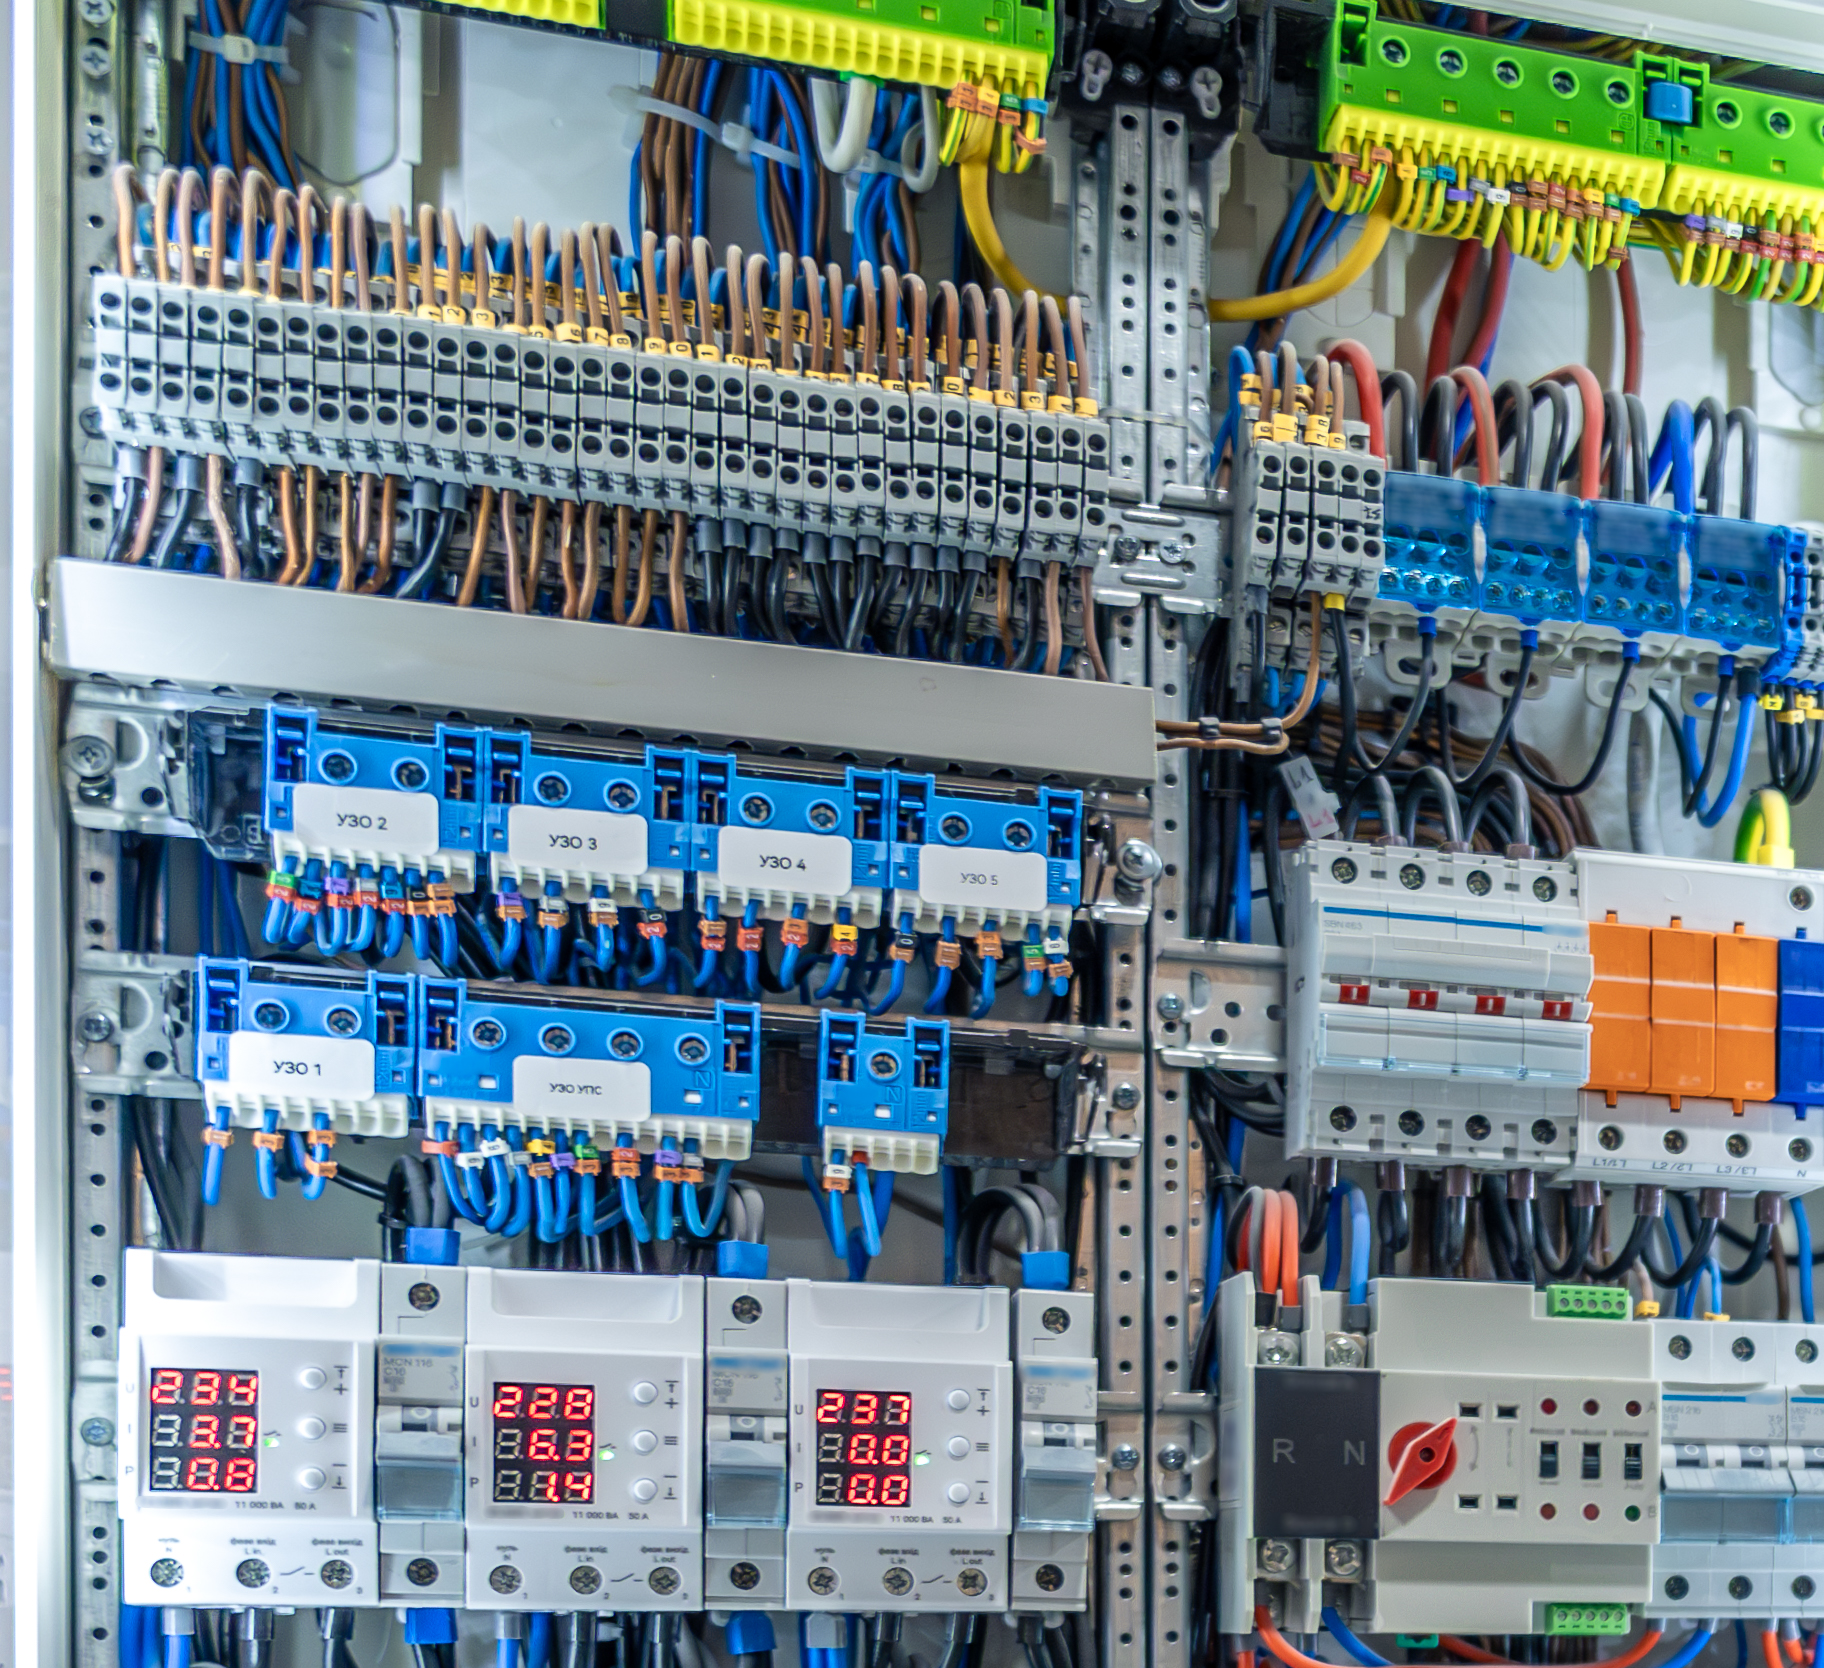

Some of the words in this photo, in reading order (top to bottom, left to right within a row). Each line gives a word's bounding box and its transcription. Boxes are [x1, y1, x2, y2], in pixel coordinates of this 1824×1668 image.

[337, 813, 373, 829] УЗО
[377, 816, 389, 830] 2
[549, 834, 583, 849] УЗО
[588, 837, 598, 850] 3
[759, 854, 792, 870] УЗО
[797, 859, 807, 871] 4
[960, 872, 988, 885] УЗО
[990, 875, 998, 886] 5
[273, 1060, 309, 1075] УЗО
[314, 1063, 322, 1076] 1
[549, 1083, 575, 1094] УЗО
[1796, 1169, 1807, 1178] N
[151, 1369, 258, 1405] 234
[470, 1396, 480, 1408] U
[493, 1385, 594, 1421] 228
[795, 1404, 804, 1415] U
[816, 1392, 911, 1426] 237
[189, 1415, 258, 1450] 3.7
[527, 1428, 594, 1462] 6.3
[847, 1433, 911, 1466] 0.0
[1273, 1437, 1296, 1464] R
[1344, 1439, 1366, 1466] N
[186, 1457, 257, 1491] 0.8
[470, 1477, 480, 1488] P
[545, 1470, 593, 1503] 1.4
[795, 1482, 804, 1493] P
[846, 1473, 910, 1505] 0.0
